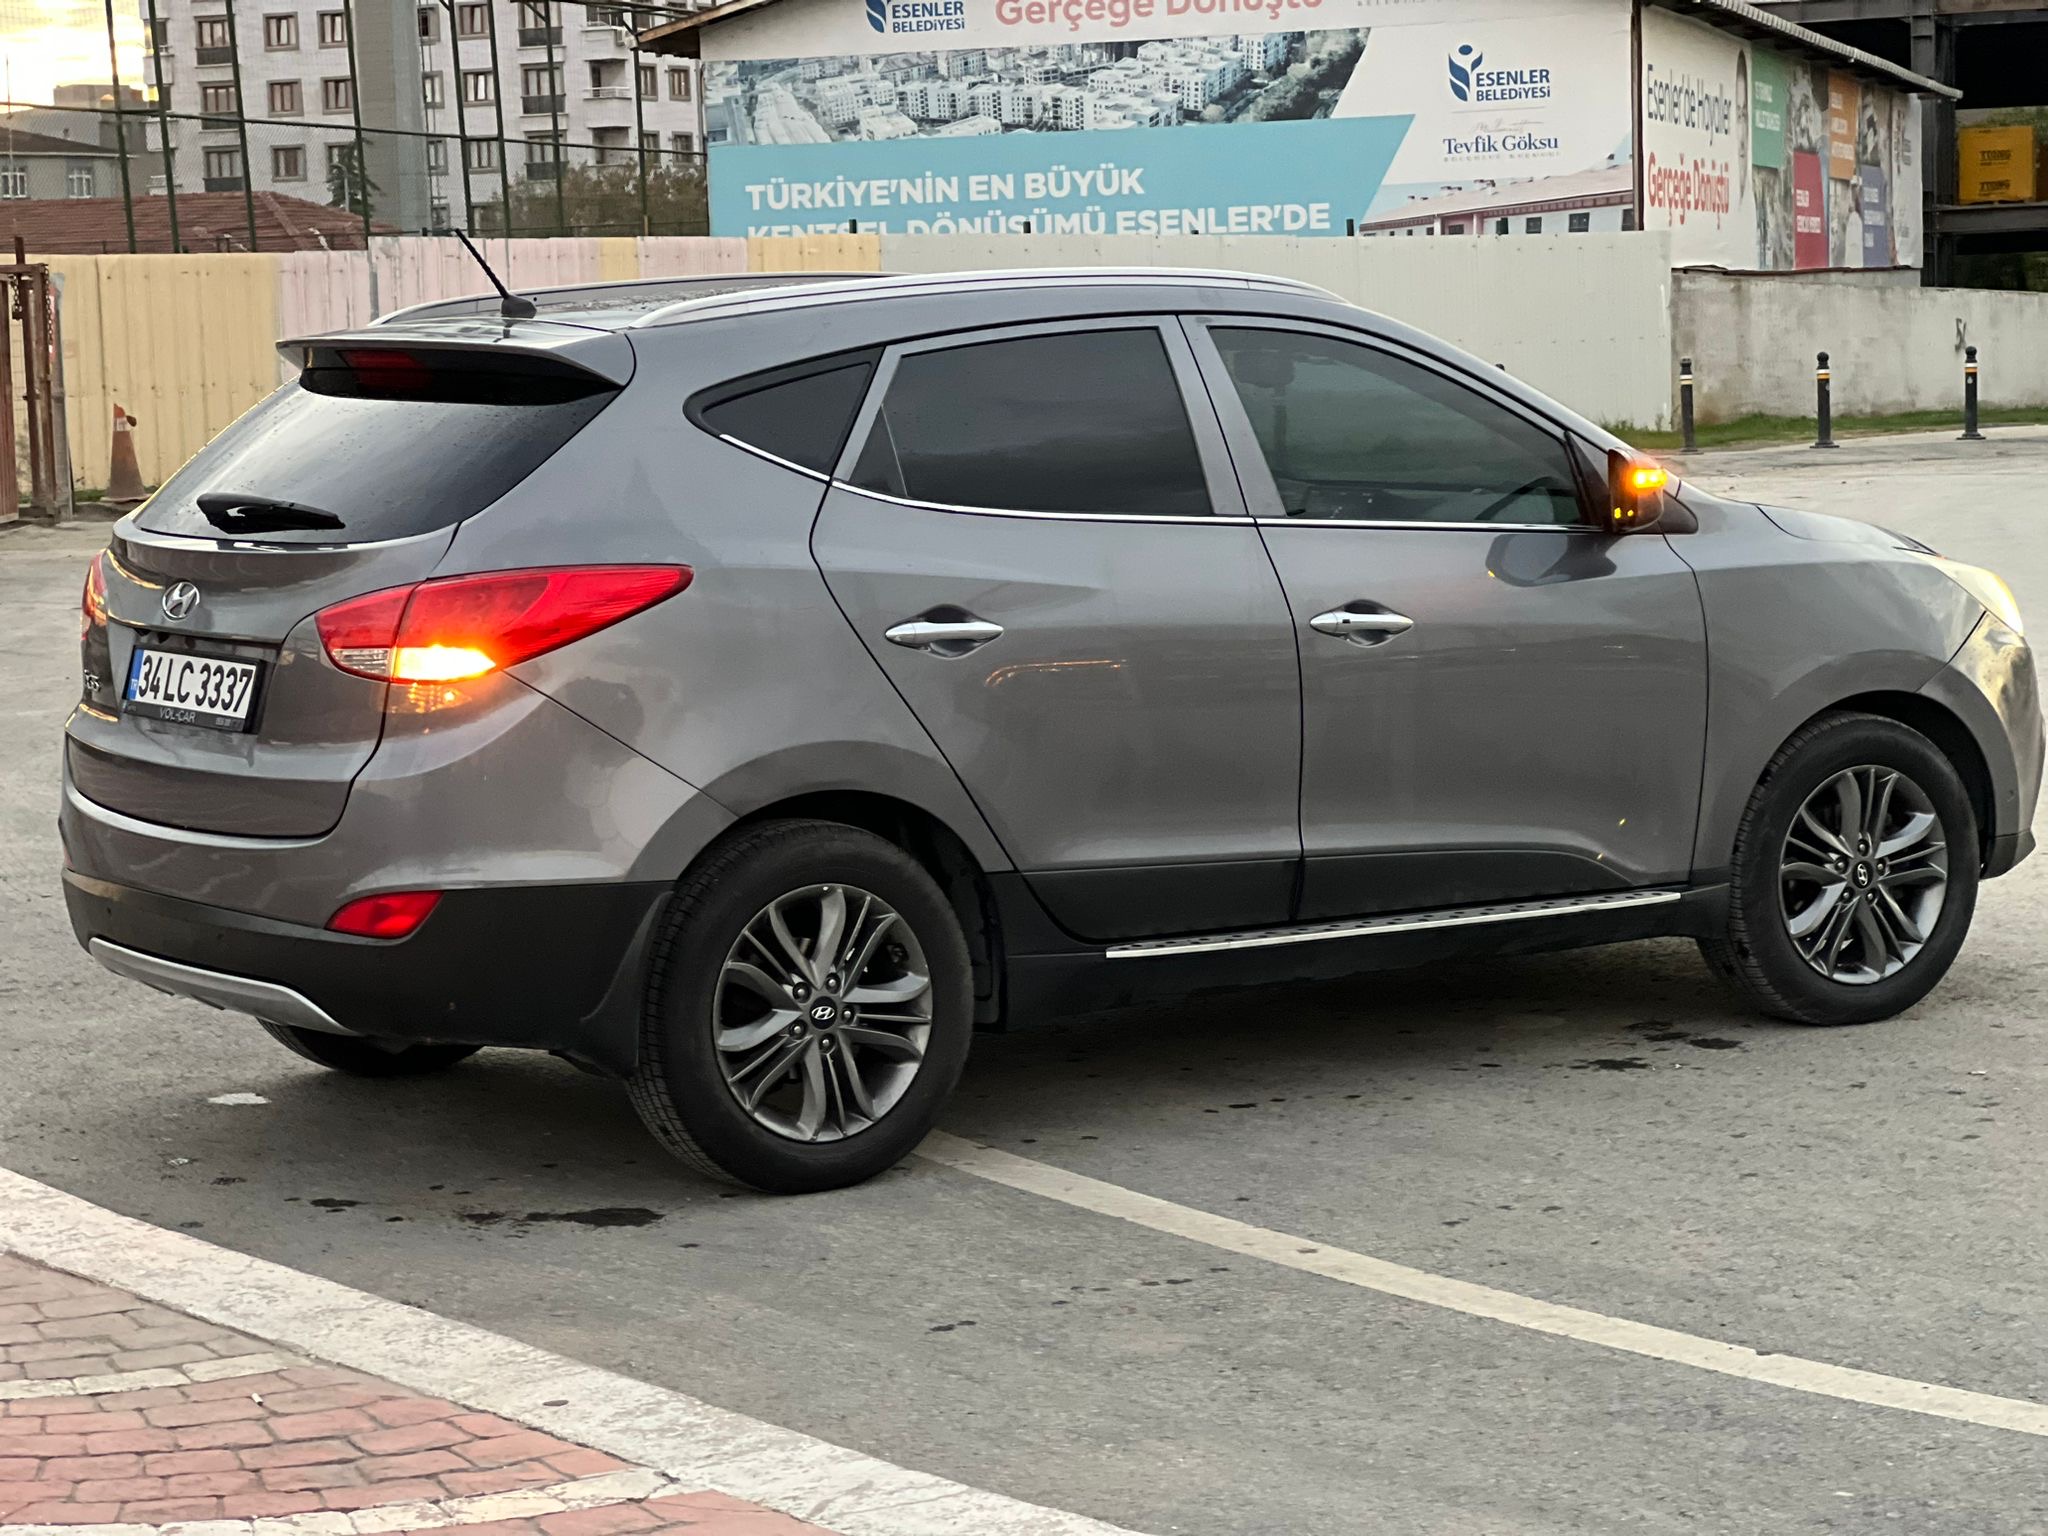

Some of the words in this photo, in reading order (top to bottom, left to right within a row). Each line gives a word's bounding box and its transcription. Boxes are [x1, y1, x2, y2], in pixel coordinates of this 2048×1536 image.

[892, 1, 964, 19] ESENLER
[1476, 69, 1550, 87] ESENLER
[1443, 135, 1498, 154] Tevfik
[1502, 132, 1559, 151] Göksu
[745, 171, 959, 210] TÜRKİYE'NİN
[969, 173, 1015, 201] EN
[1024, 163, 1145, 199] BÜYÜK
[1116, 203, 1331, 235] ESENLER'DE
